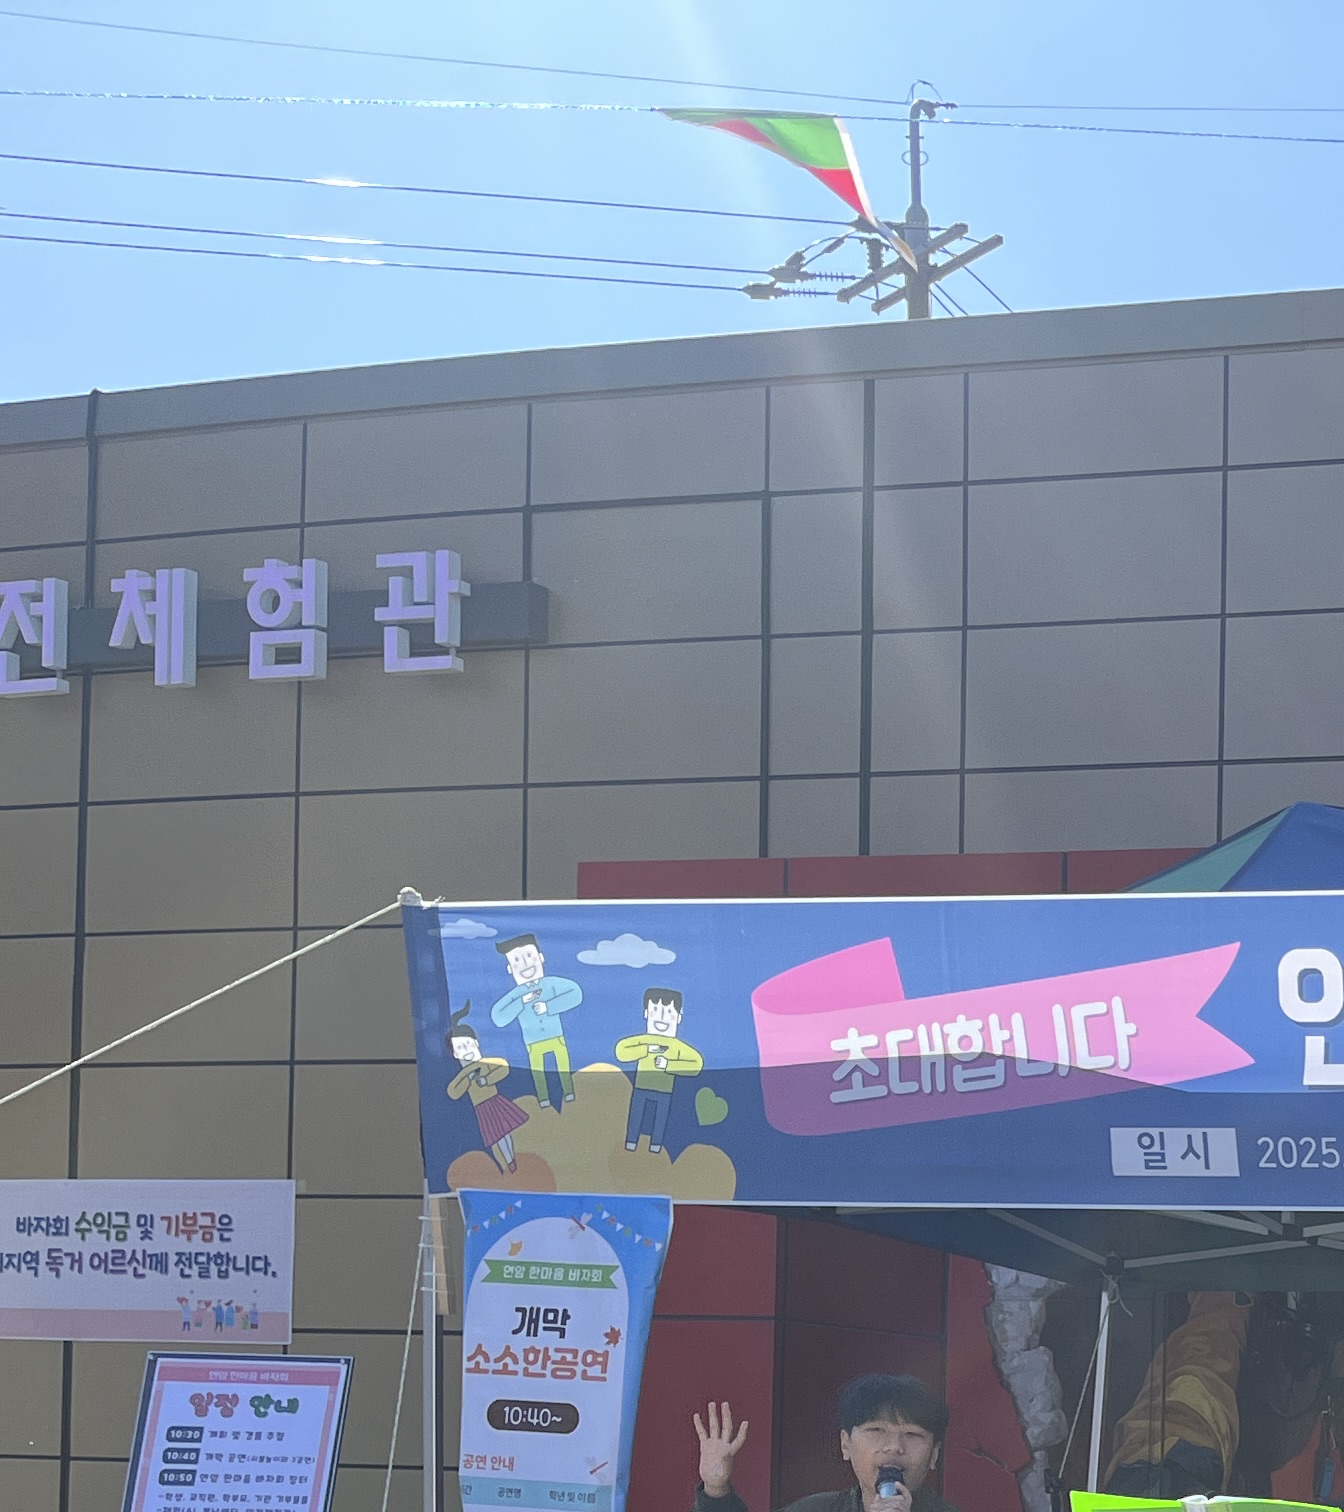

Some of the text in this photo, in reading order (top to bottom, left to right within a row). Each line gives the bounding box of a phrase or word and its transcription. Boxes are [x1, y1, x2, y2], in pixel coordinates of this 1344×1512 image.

[829, 995, 1137, 1105] 초대합니다
[16, 1210, 234, 1243] 바자회 수익금 및 기부금은
[0, 1248, 277, 1280] 지역 독거 어르신께 전달합니다.
[503, 1265, 603, 1283] 연암 한마음 바자회
[511, 1306, 571, 1339] 개막
[465, 1345, 609, 1382] 소소한공연
[190, 1392, 299, 1418] 일정 안내
[502, 1404, 562, 1427] 10:40~
[170, 1429, 201, 1440] 10:30
[166, 1451, 197, 1461] 10:40
[463, 1453, 515, 1472] 공연 안내
[162, 1473, 193, 1483] 10:50
[577, 1492, 597, 1504] 이름
